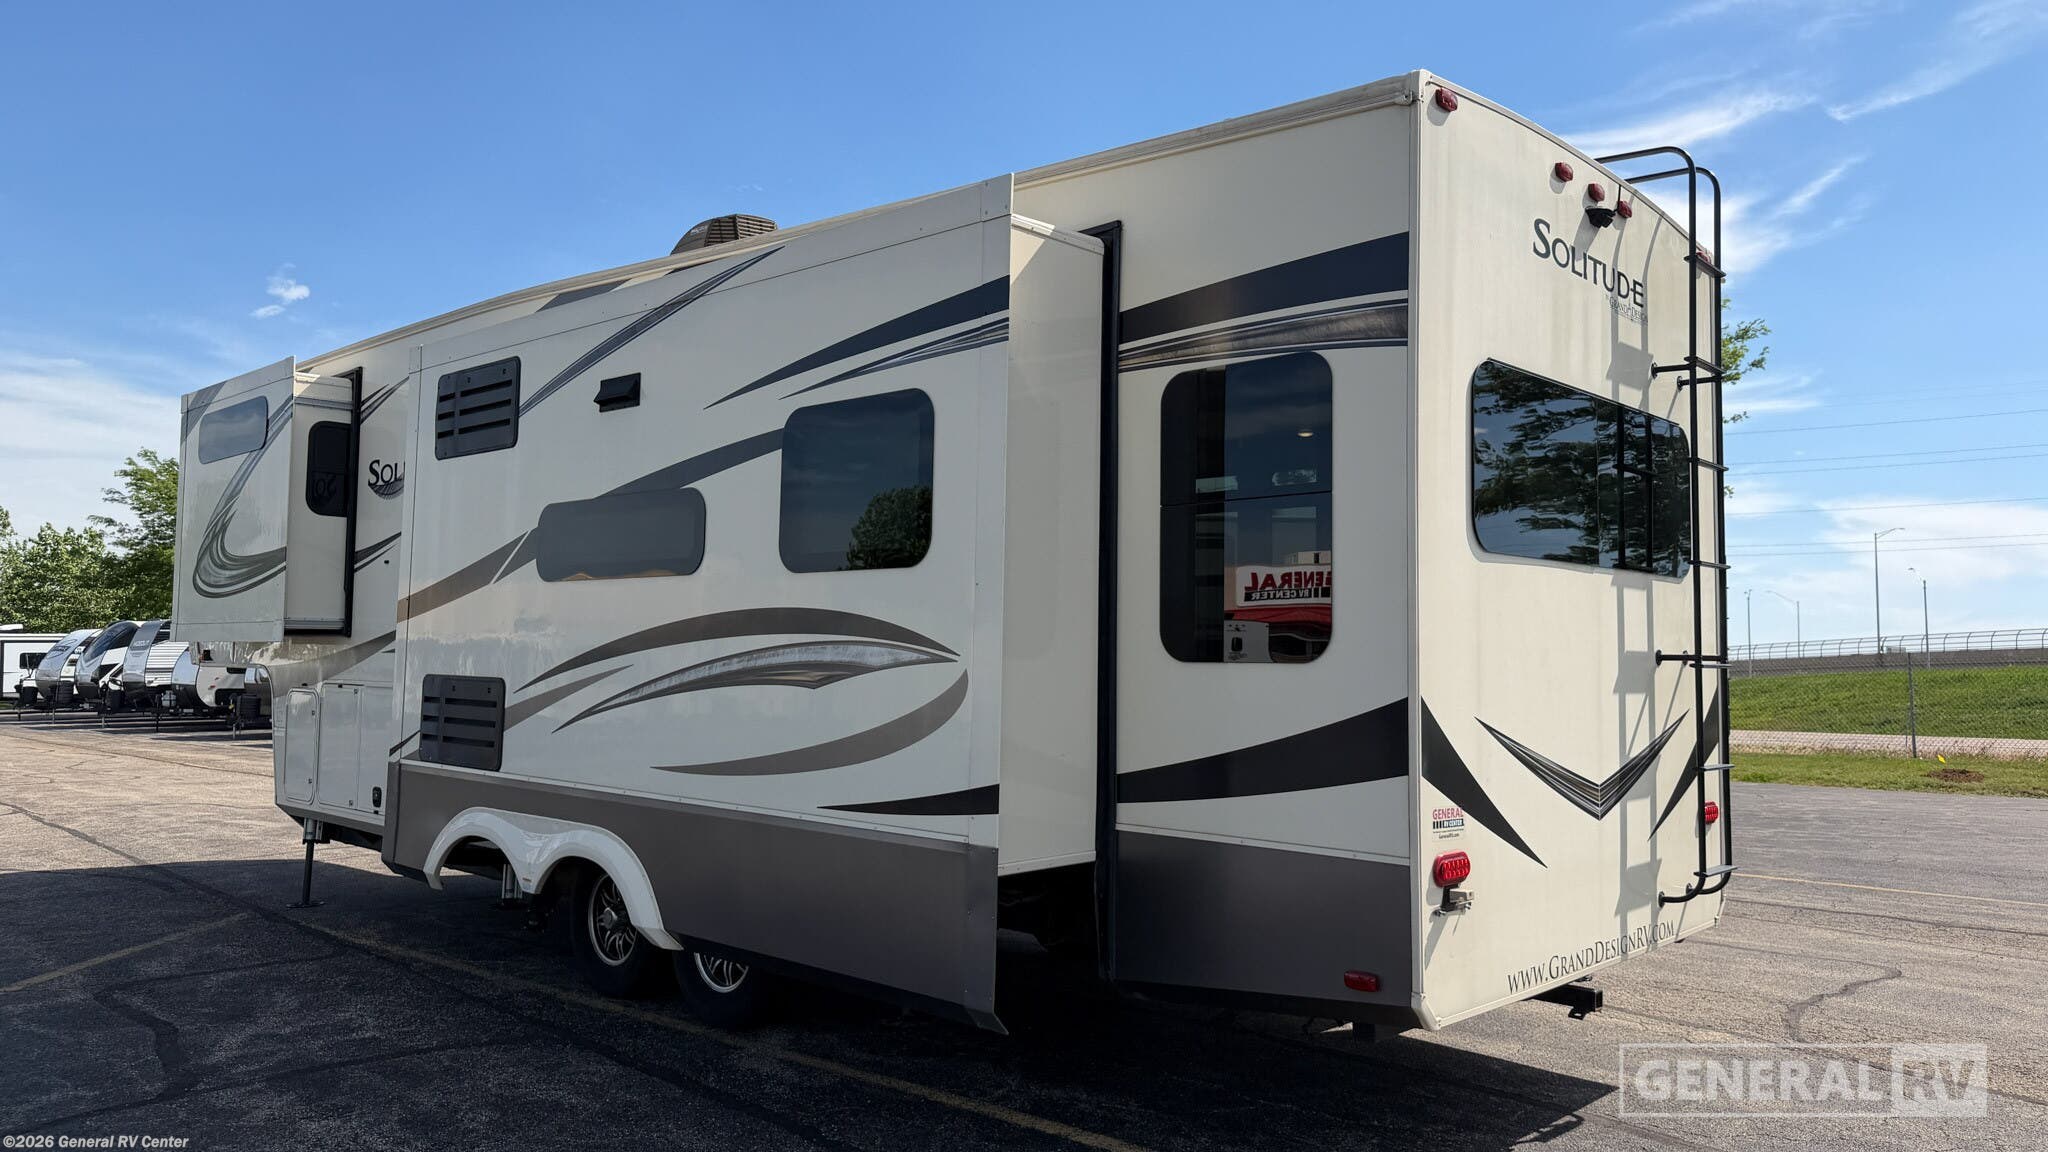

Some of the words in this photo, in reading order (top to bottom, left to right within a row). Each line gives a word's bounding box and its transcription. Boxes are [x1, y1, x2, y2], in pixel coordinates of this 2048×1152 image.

[1533, 218, 1644, 308] SOLITUDE
[368, 459, 405, 486] SOL
[1432, 807, 1464, 820] GENERAL
